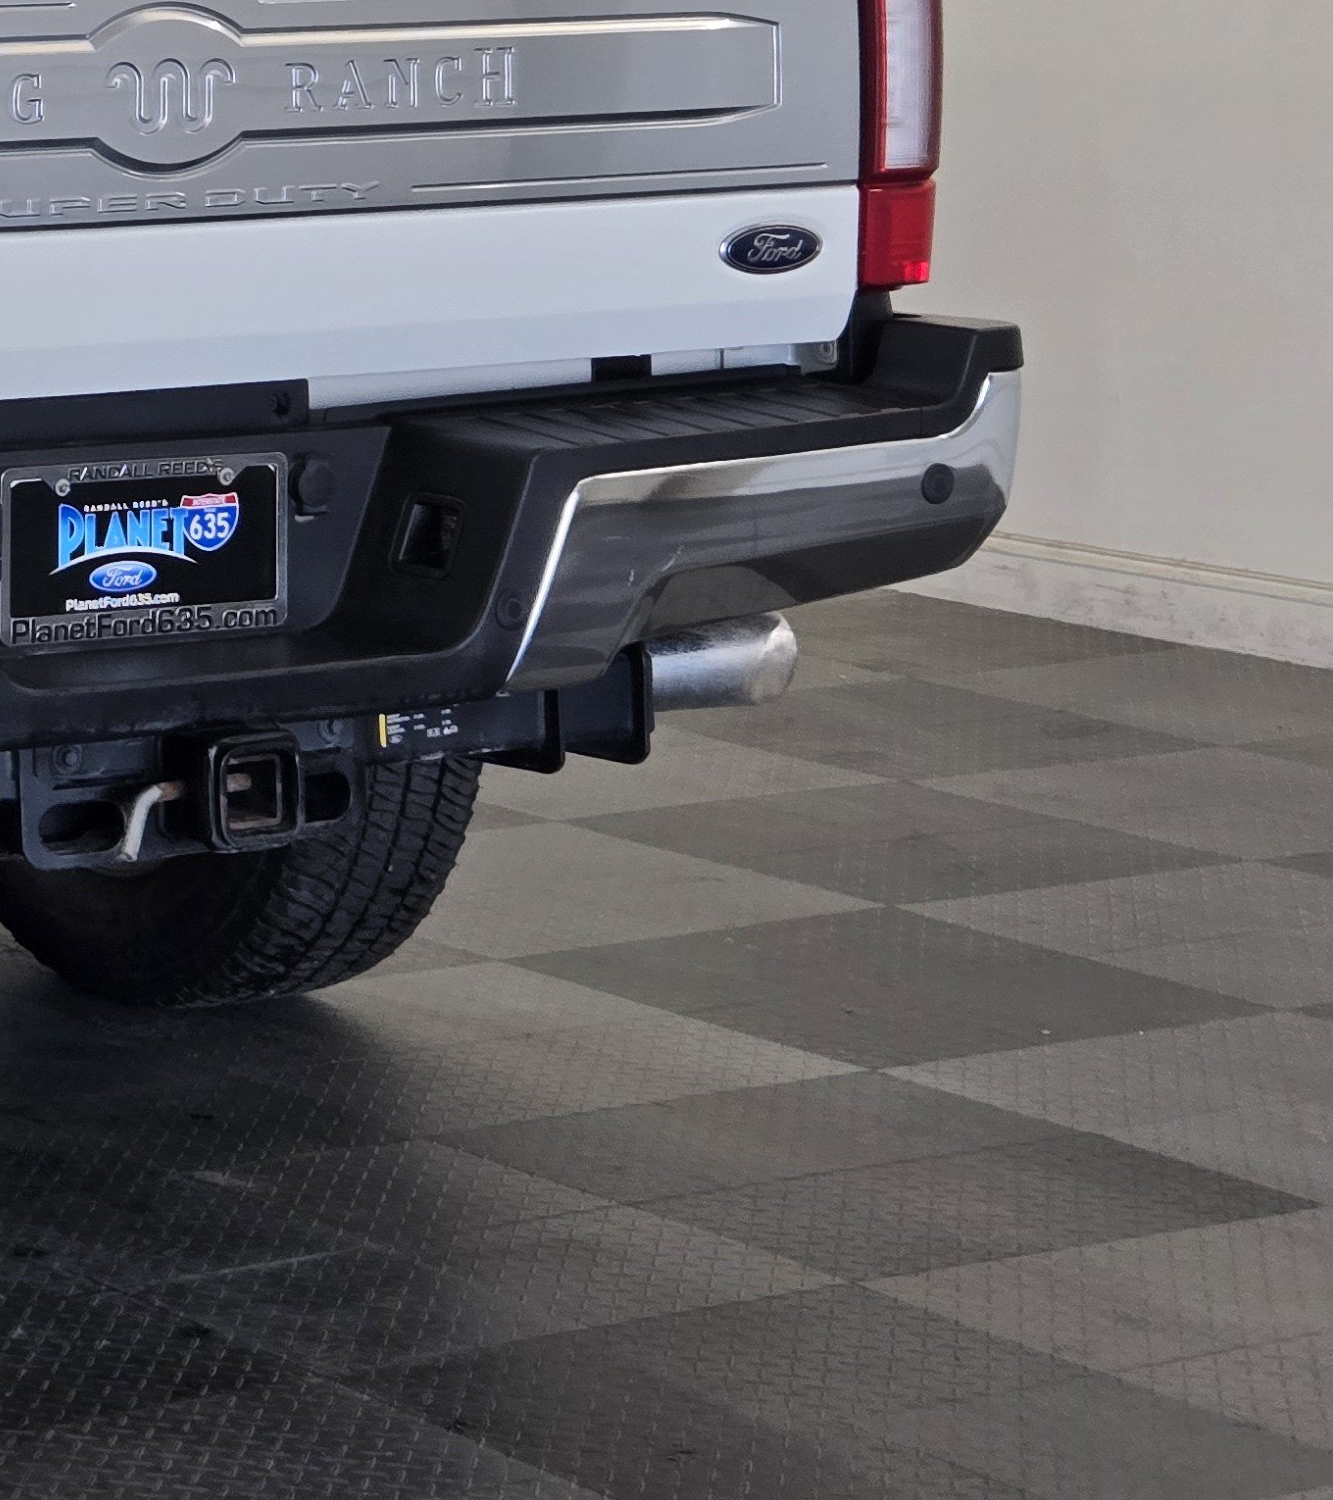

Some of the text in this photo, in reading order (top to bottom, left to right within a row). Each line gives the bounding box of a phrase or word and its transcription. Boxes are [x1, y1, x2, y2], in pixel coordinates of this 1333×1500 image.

[283, 45, 518, 113] RANCH
[203, 180, 381, 208] DUTY
[747, 233, 804, 262] Ford
[68, 464, 153, 481] RANDALL
[57, 502, 230, 570] PLANET 635
[102, 565, 142, 588] Ford
[65, 591, 180, 612] PlanetFord635.com
[11, 605, 278, 645] PlanetFord635.com
